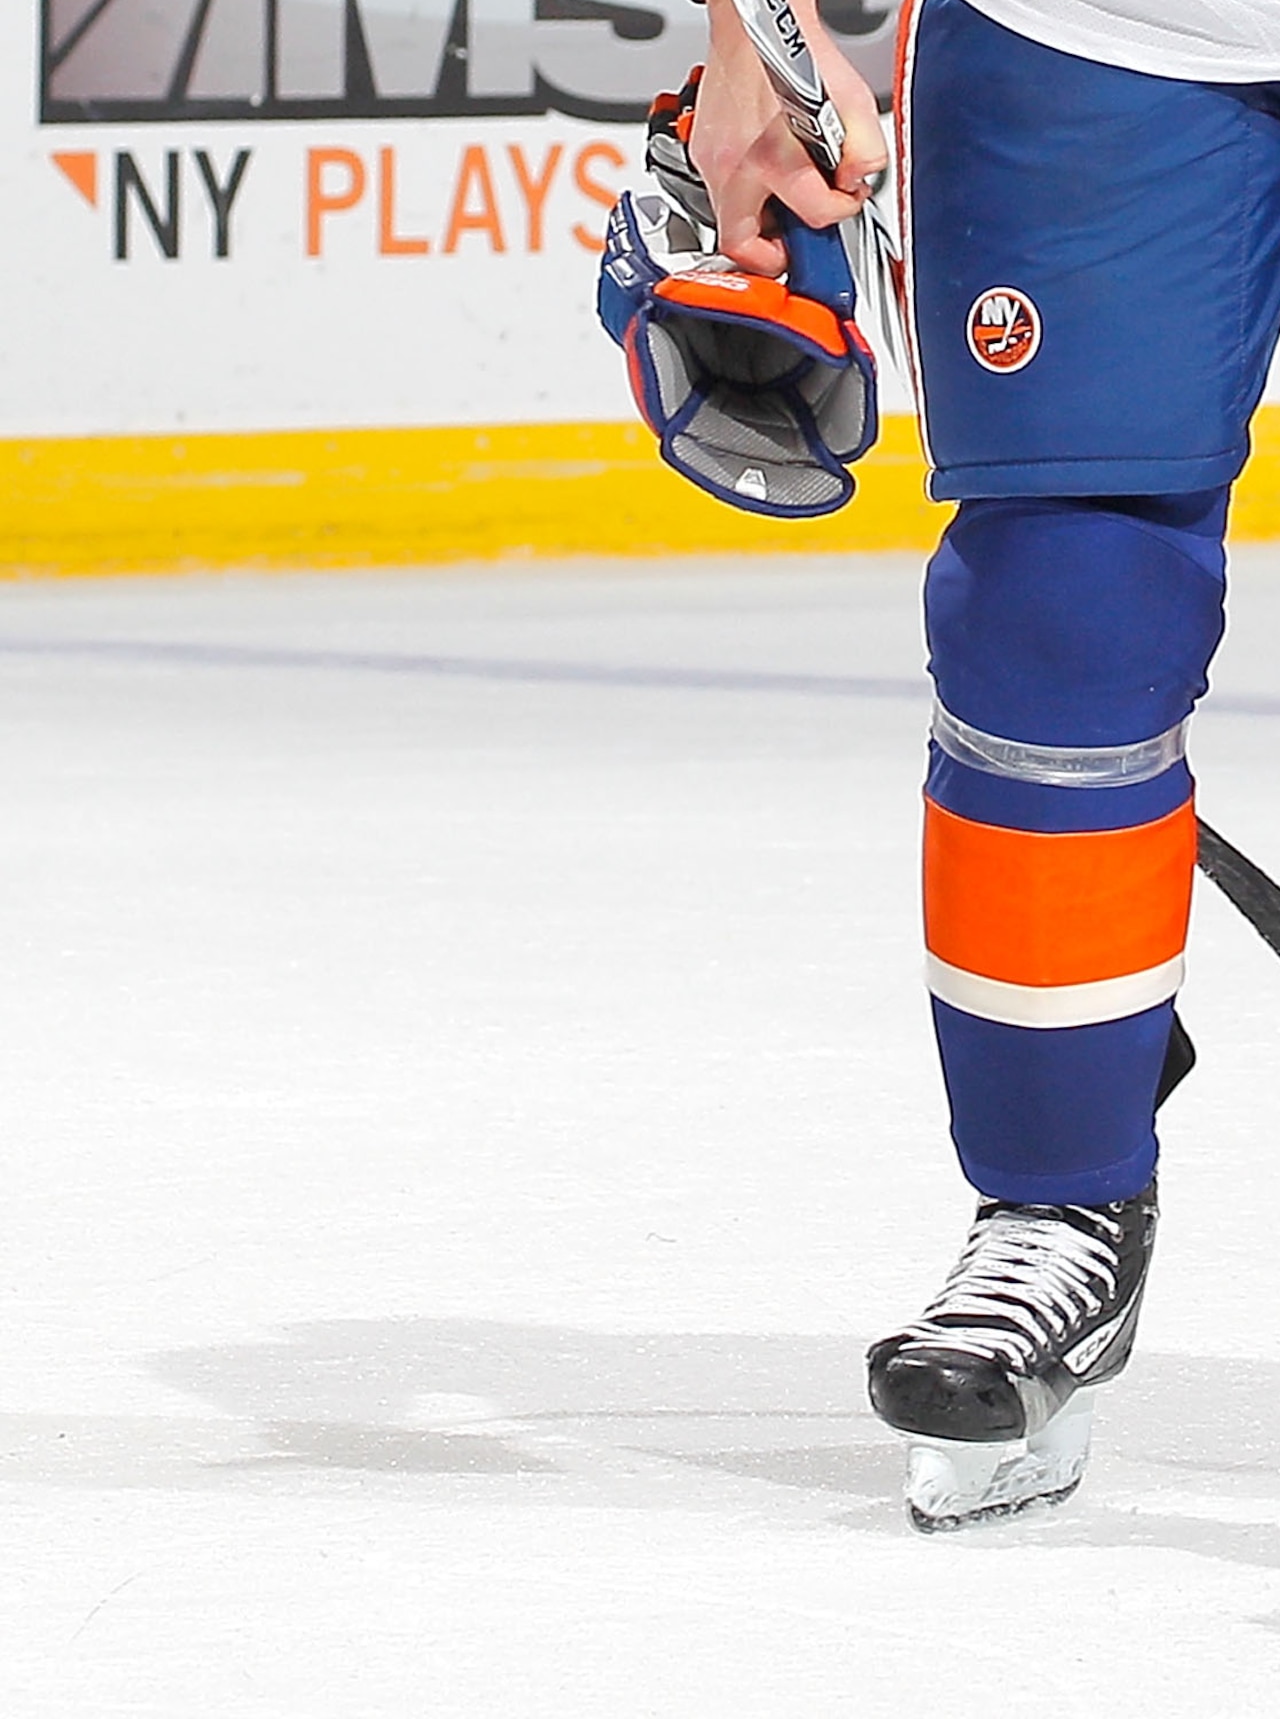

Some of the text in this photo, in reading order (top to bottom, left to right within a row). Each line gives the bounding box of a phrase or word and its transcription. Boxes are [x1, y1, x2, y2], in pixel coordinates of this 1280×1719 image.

[114, 143, 626, 260] NY PLAYS
[981, 295, 1021, 340] NY
